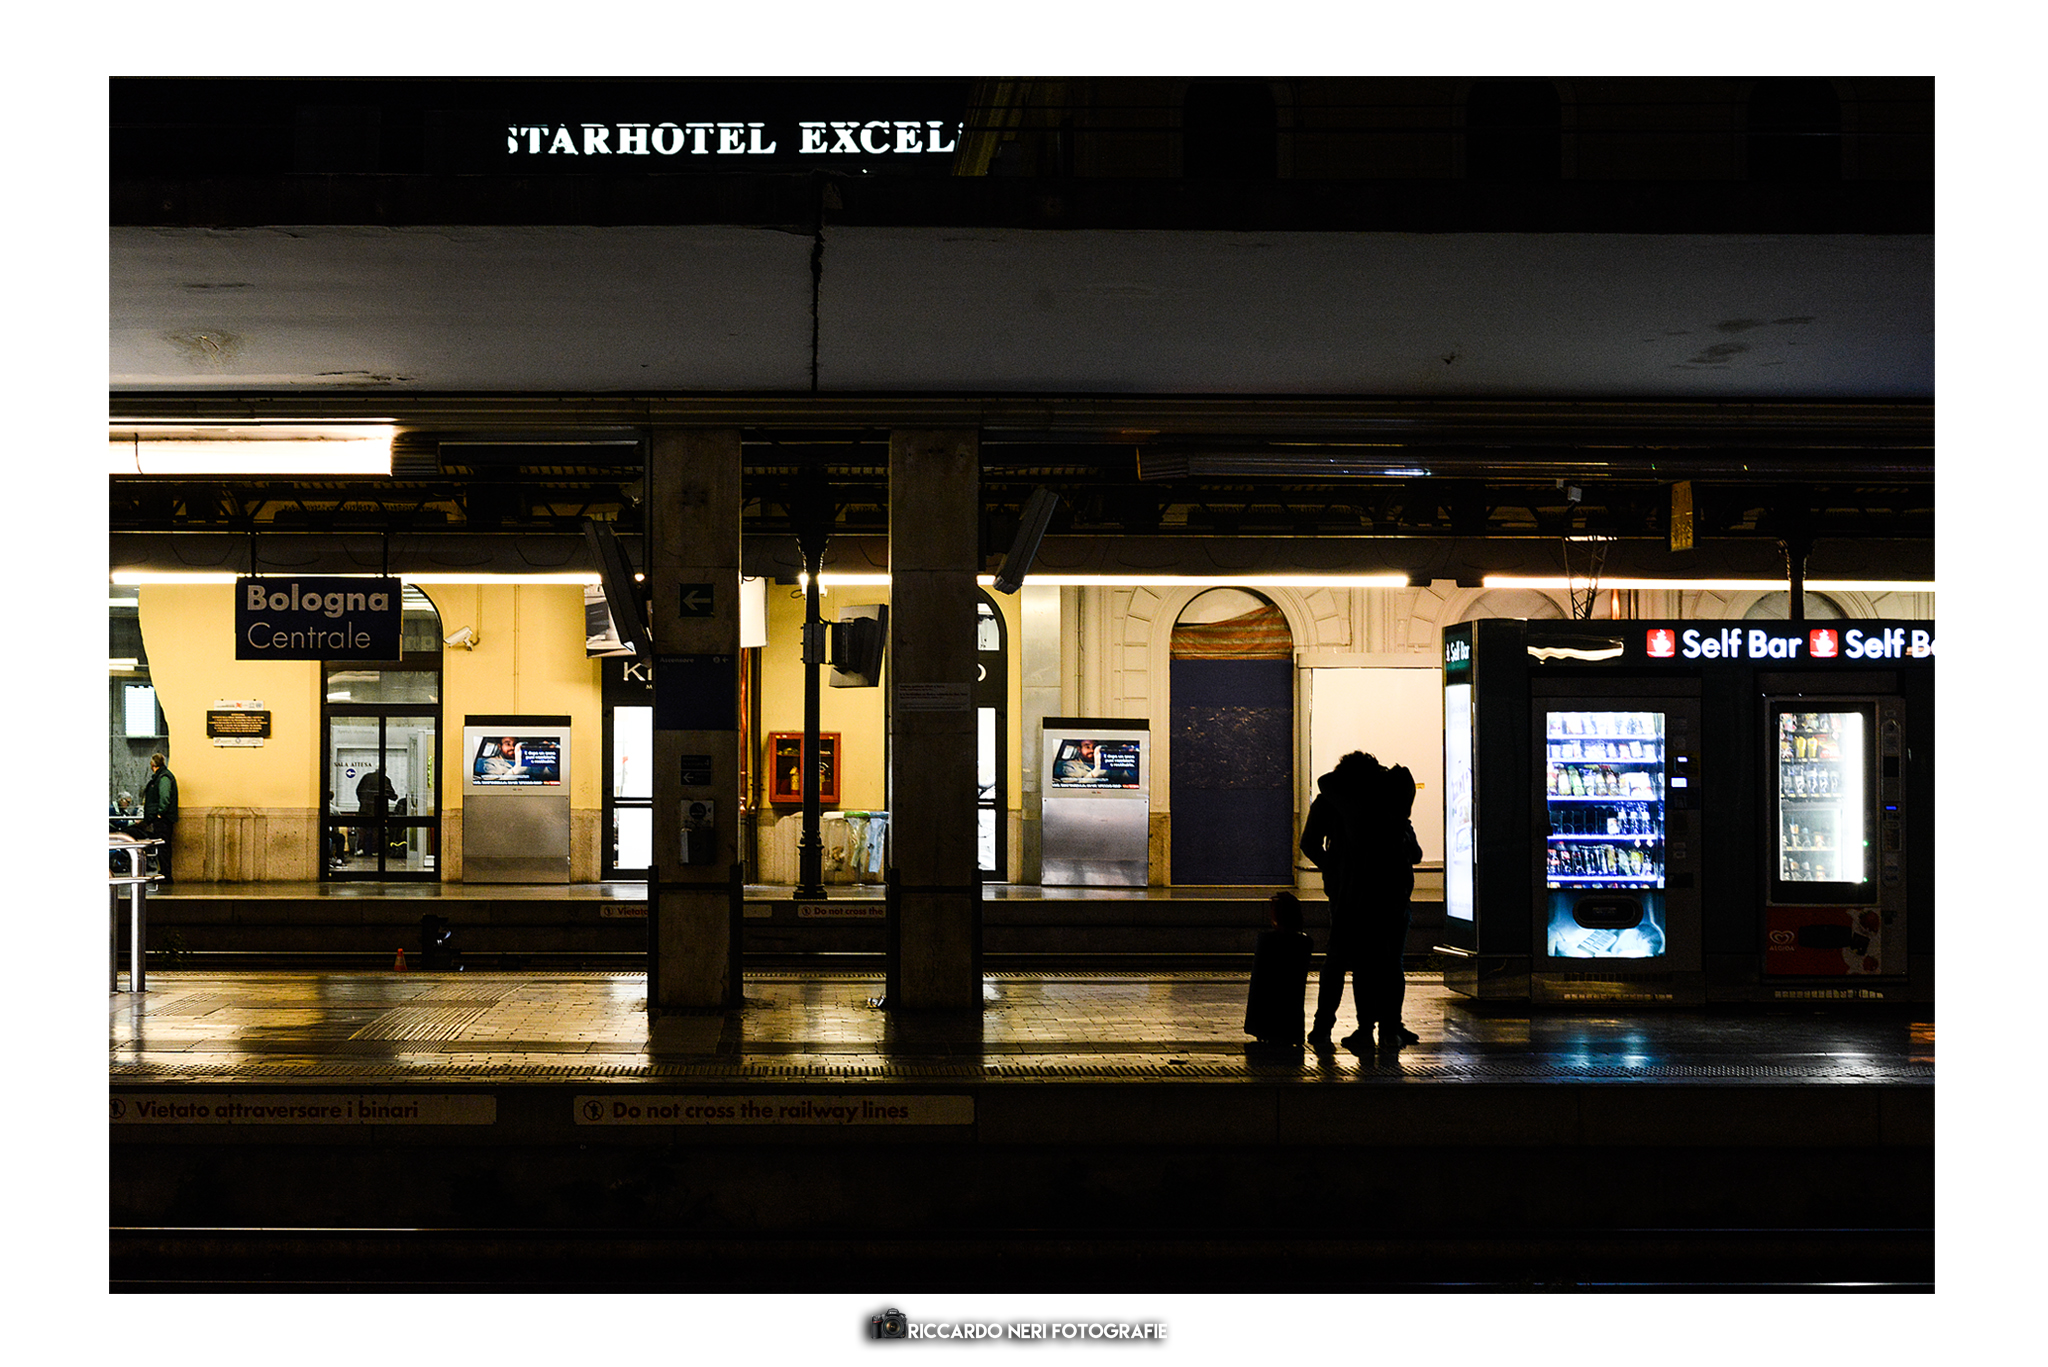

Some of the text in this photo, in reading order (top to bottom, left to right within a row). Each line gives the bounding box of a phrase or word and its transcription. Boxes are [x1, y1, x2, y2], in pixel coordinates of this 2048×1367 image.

[799, 120, 964, 155] EXCEL
[246, 583, 389, 618] Bologna
[247, 621, 371, 649] Centrale
[1682, 628, 1935, 658] Self Bar Self B
[814, 907, 827, 915] Do
[869, 907, 884, 915] the
[136, 1101, 419, 1118] Vietato attraversare i binari
[612, 1101, 909, 1123] Do not cross the railway lines
